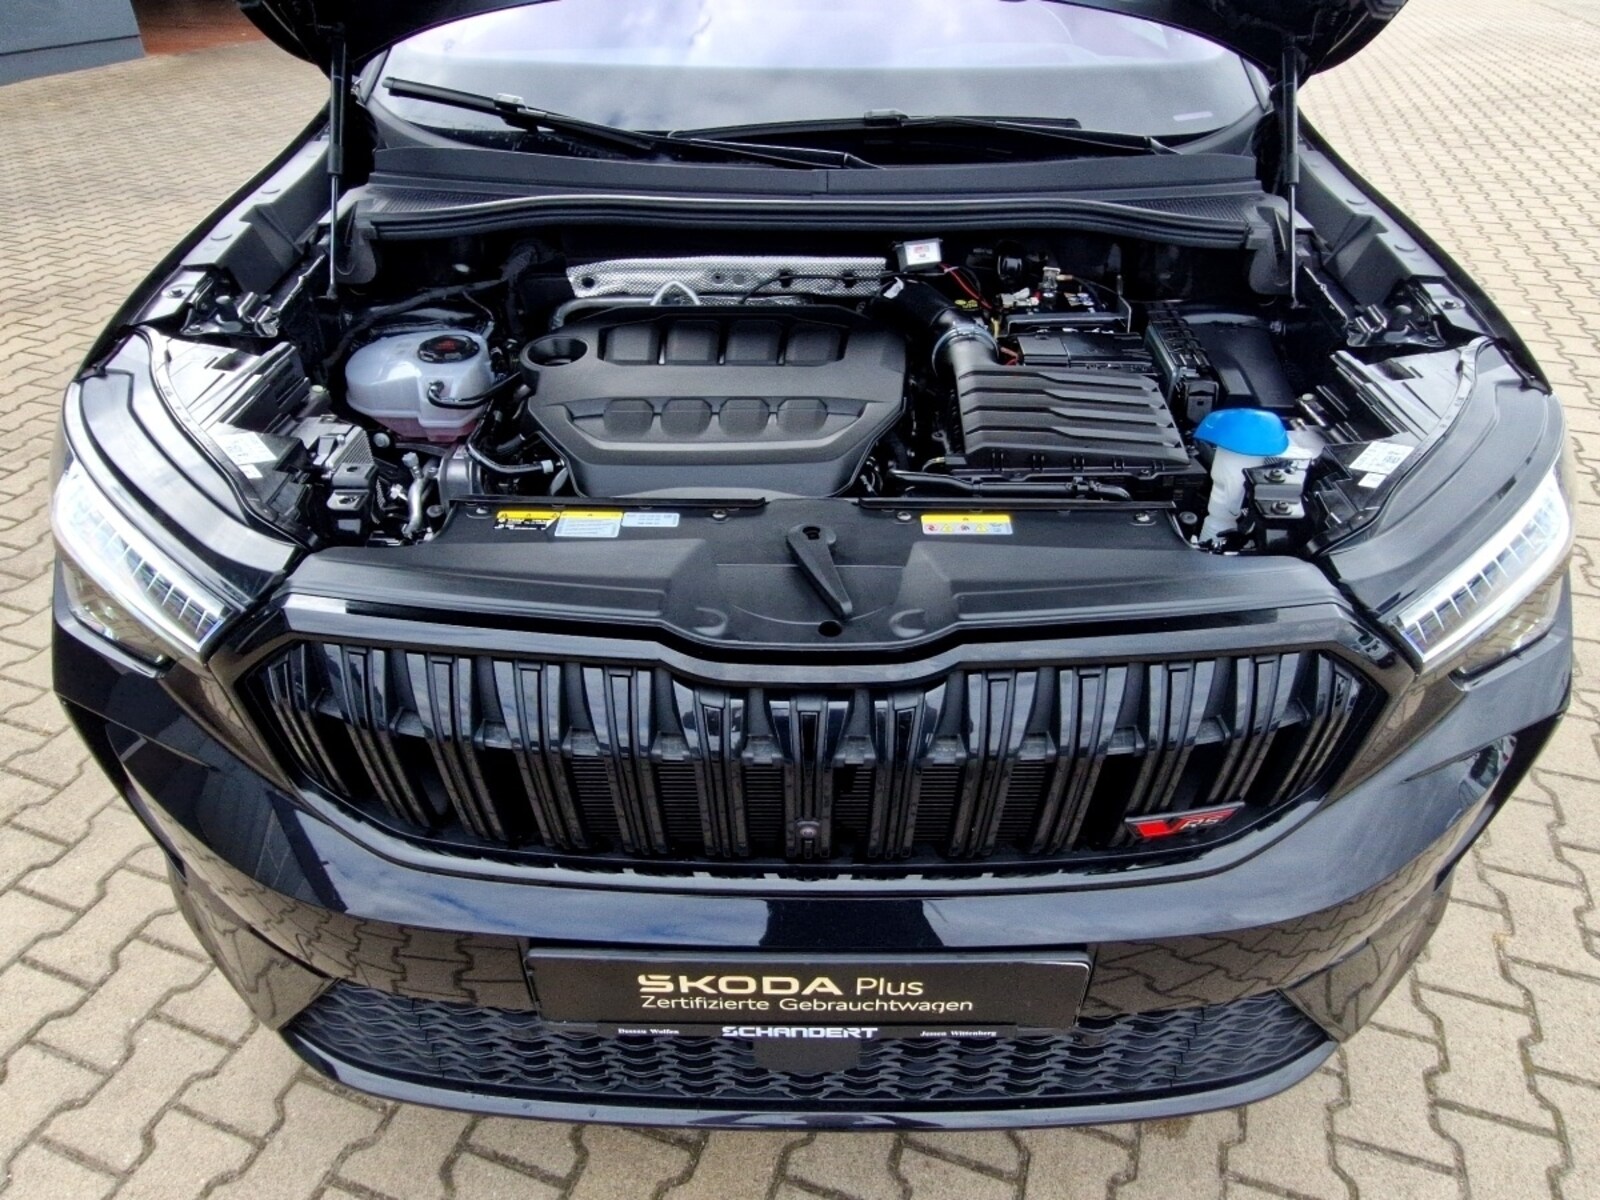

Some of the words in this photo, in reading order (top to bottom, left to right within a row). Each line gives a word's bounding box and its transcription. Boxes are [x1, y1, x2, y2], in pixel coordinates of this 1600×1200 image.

[855, 976, 924, 996] Plus
[639, 995, 770, 1011] Zertifizierte
[778, 998, 974, 1014] Gebrauchtwagen
[721, 1025, 879, 1039] SCHANDERT
